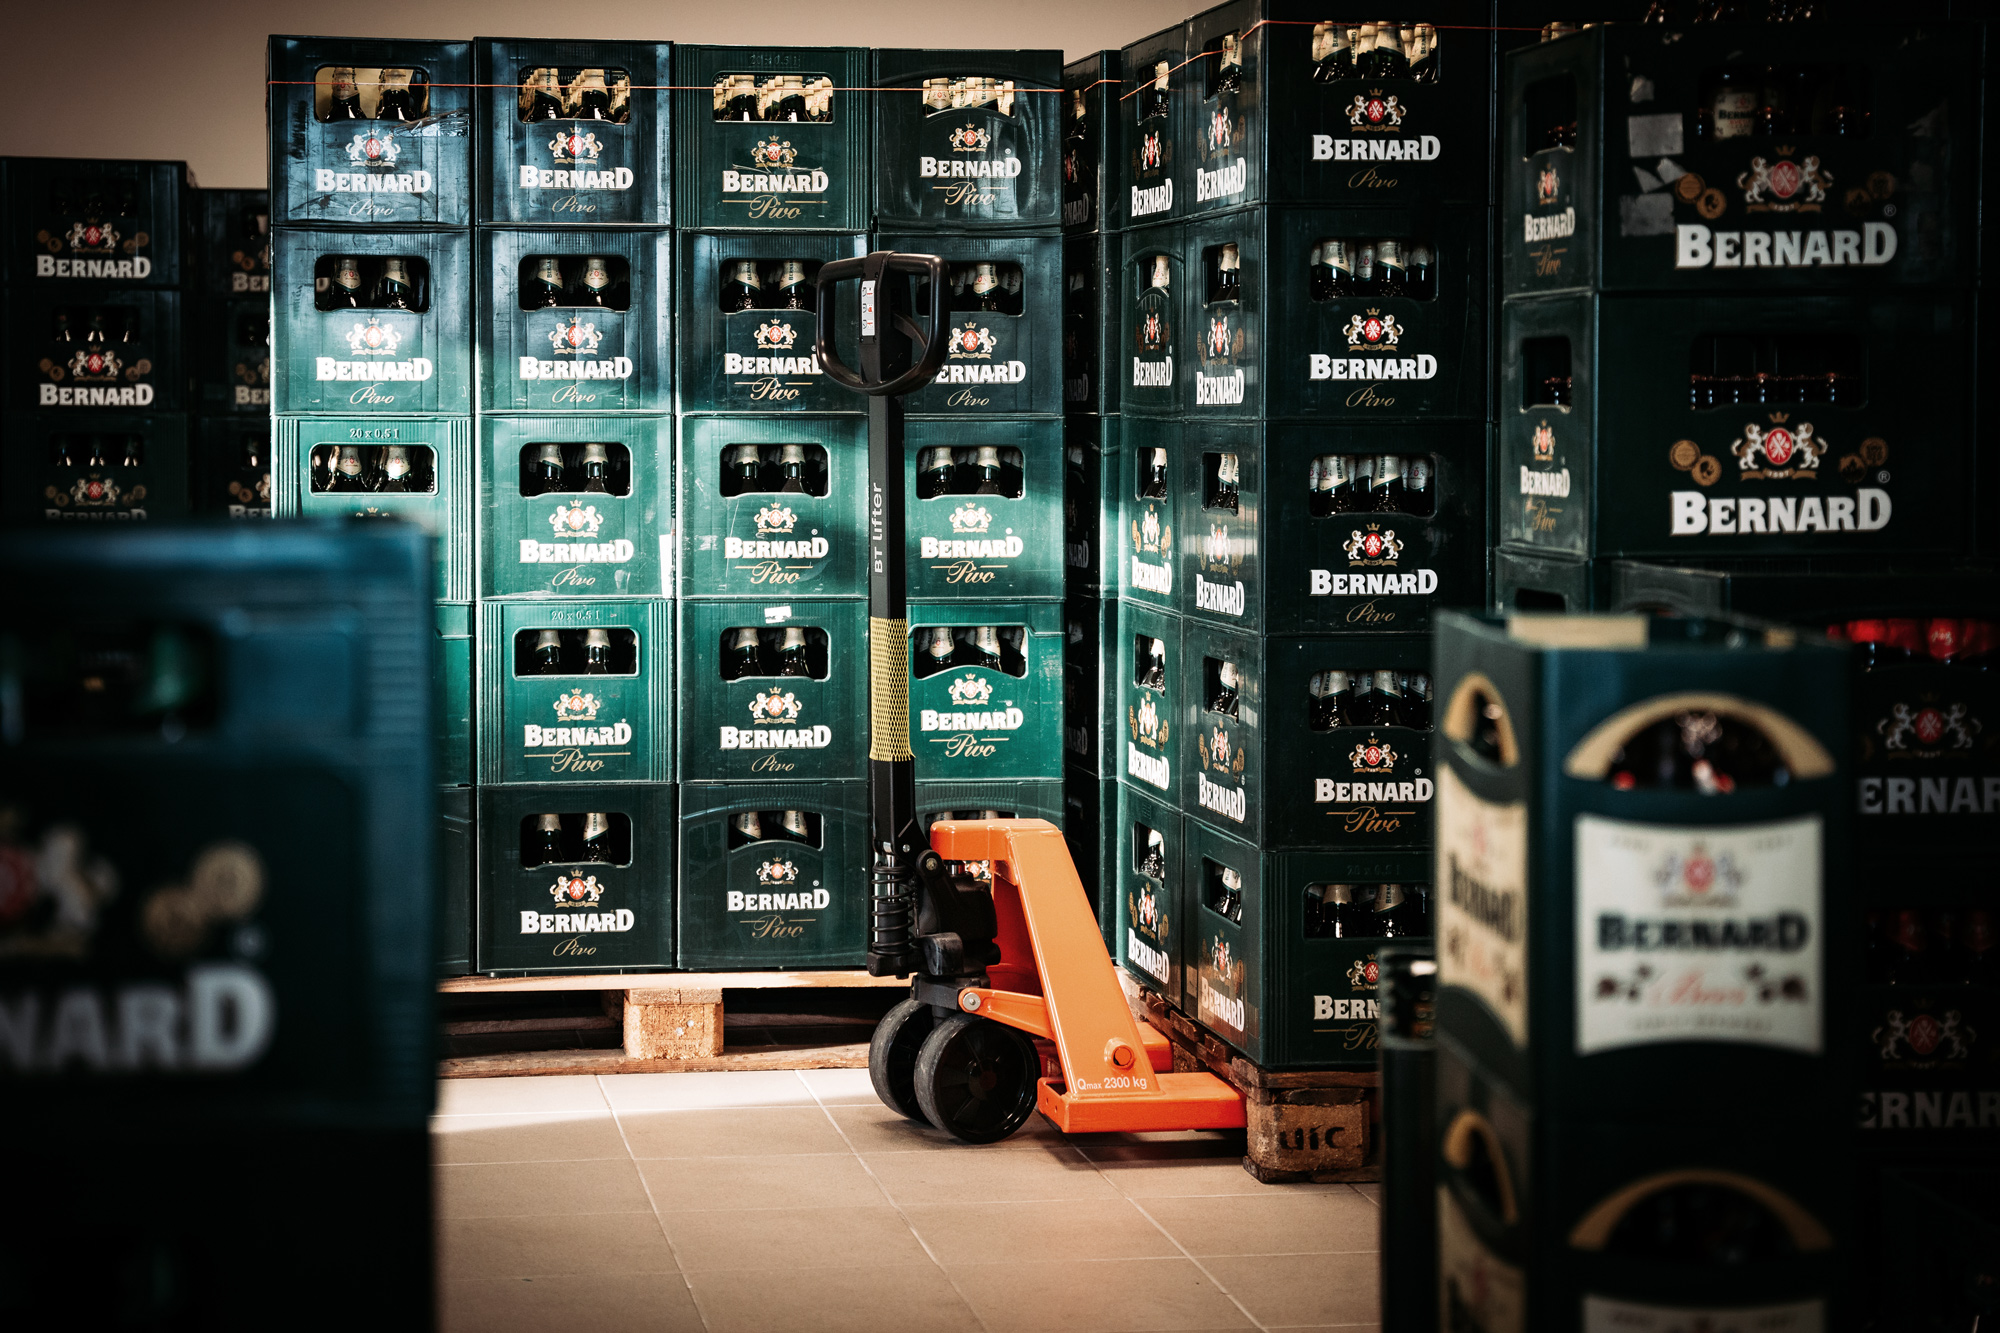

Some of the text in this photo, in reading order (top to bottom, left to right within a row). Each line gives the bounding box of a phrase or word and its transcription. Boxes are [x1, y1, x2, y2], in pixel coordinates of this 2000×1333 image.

[1311, 134, 1441, 162] BERNARD
[519, 165, 634, 190] BERNARD
[920, 156, 1022, 179] BERNARD
[1348, 164, 1398, 189] Pivo
[315, 168, 432, 193] BERNARD
[722, 170, 829, 194] BERNARD
[1196, 157, 1246, 204] BERNARD
[551, 193, 597, 214] Pivo
[945, 181, 995, 206] Pivo
[1131, 177, 1173, 218] BERNARD
[349, 197, 395, 217] Pivo
[748, 195, 801, 220] Pivo
[1524, 206, 1576, 243] BERNARD
[1675, 221, 1898, 269] BERNARD
[36, 254, 151, 279] BERNARD
[316, 357, 433, 382] BERNARD
[519, 356, 634, 381] BERNARD
[935, 360, 1026, 385] ERNARD
[1133, 356, 1173, 387] BERNARD
[1309, 354, 1437, 381] BERNARD
[38, 383, 154, 407] BERNARD
[349, 383, 395, 405] Pivo
[552, 381, 596, 404] Pivo
[750, 377, 801, 401] Pivo
[947, 386, 990, 407] Pivo
[1196, 369, 1244, 405] BERNARD
[1346, 383, 1395, 408] Pivo
[350, 428, 363, 438] 20
[1520, 465, 1571, 498] BERNARD
[1669, 488, 1892, 537] BERNARD
[519, 539, 634, 563] BERNARD
[724, 536, 829, 559] BERNARD
[874, 546, 883, 573] BT
[921, 536, 1023, 559] BERNARD
[552, 564, 596, 587] Pivo
[750, 560, 801, 584] Pivo
[946, 560, 995, 584] Pivo
[1309, 569, 1438, 596] BERNARD
[1196, 574, 1245, 617] BERNARD
[1346, 598, 1396, 623] Pivo
[920, 707, 1024, 731] BERNARD
[524, 722, 632, 747] BERNARD
[719, 724, 832, 750] BERNARD
[945, 733, 996, 757] Pivo
[551, 748, 605, 773] Pivo
[751, 751, 795, 773] Pivo
[1199, 772, 1246, 823] BERNARD
[1314, 778, 1434, 803] BERNARD
[1858, 776, 2000, 814] ERNAR
[1344, 806, 1401, 833] Pivo
[727, 888, 830, 912] BERNARD
[520, 908, 634, 934] BERNARD
[750, 915, 805, 939] Pivo
[1597, 910, 1810, 955] BERNARD
[553, 934, 597, 957] Pivo
[1128, 928, 1170, 984] BERNARD
[0, 958, 280, 1076] NARD
[1201, 977, 1245, 1032] BERNARD
[1313, 995, 1380, 1020] BERN
[1104, 1076, 1130, 1089] 2300
[1132, 1076, 1147, 1090] kg
[1858, 1090, 2000, 1129] ERNAR
